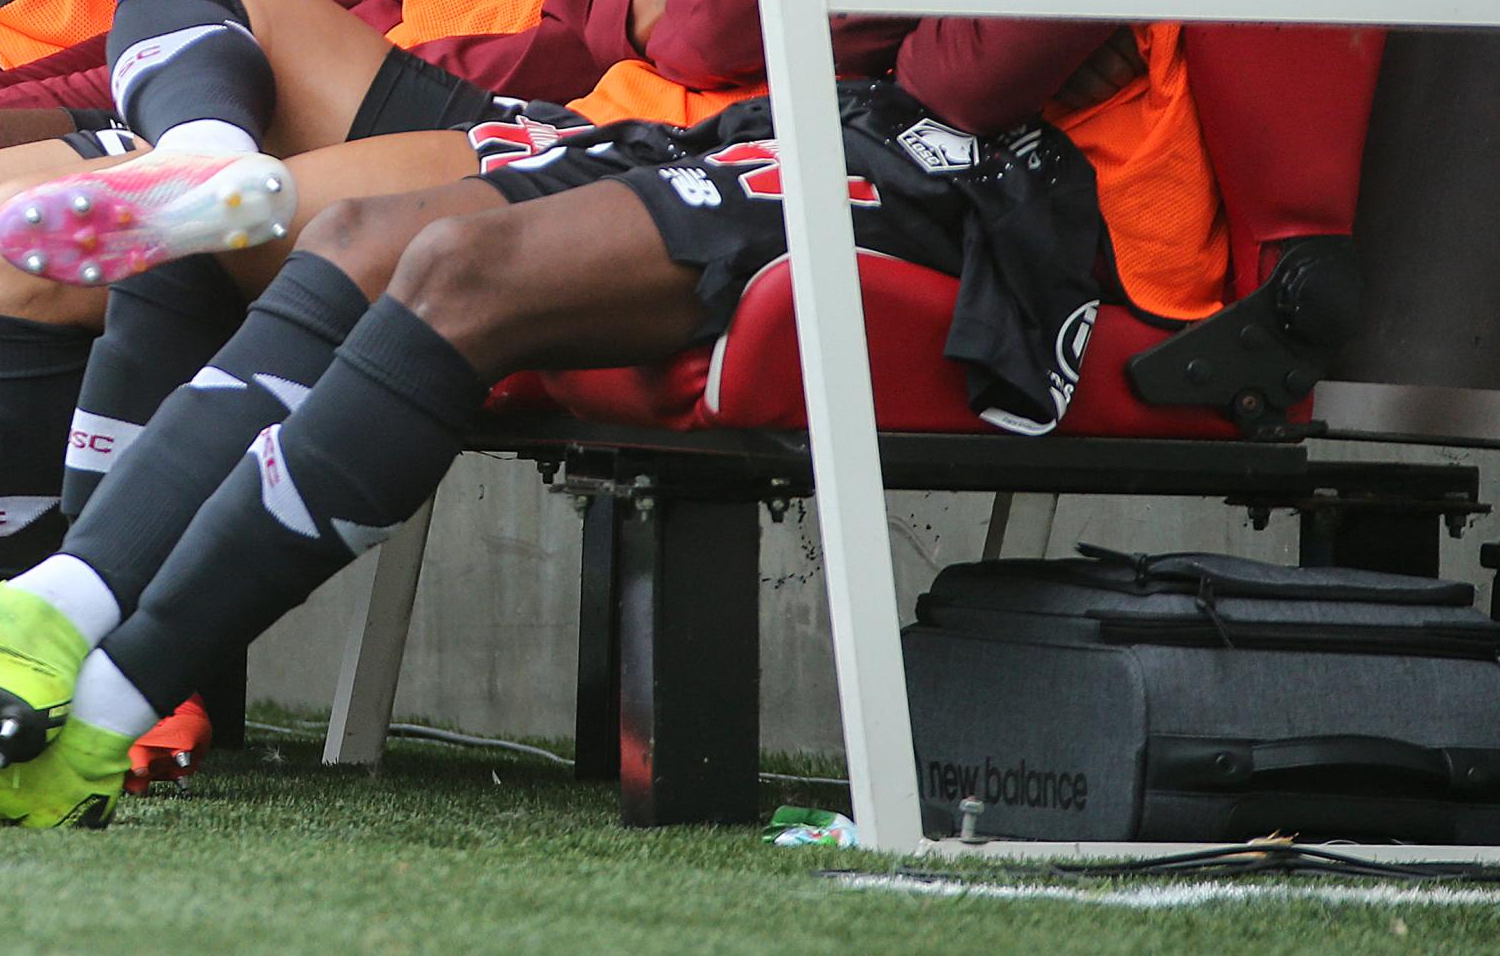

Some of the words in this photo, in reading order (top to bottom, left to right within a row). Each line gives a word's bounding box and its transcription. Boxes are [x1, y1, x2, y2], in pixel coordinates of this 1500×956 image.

[67, 430, 114, 454] SC
[930, 762, 980, 803] new
[984, 756, 1088, 811] balance
